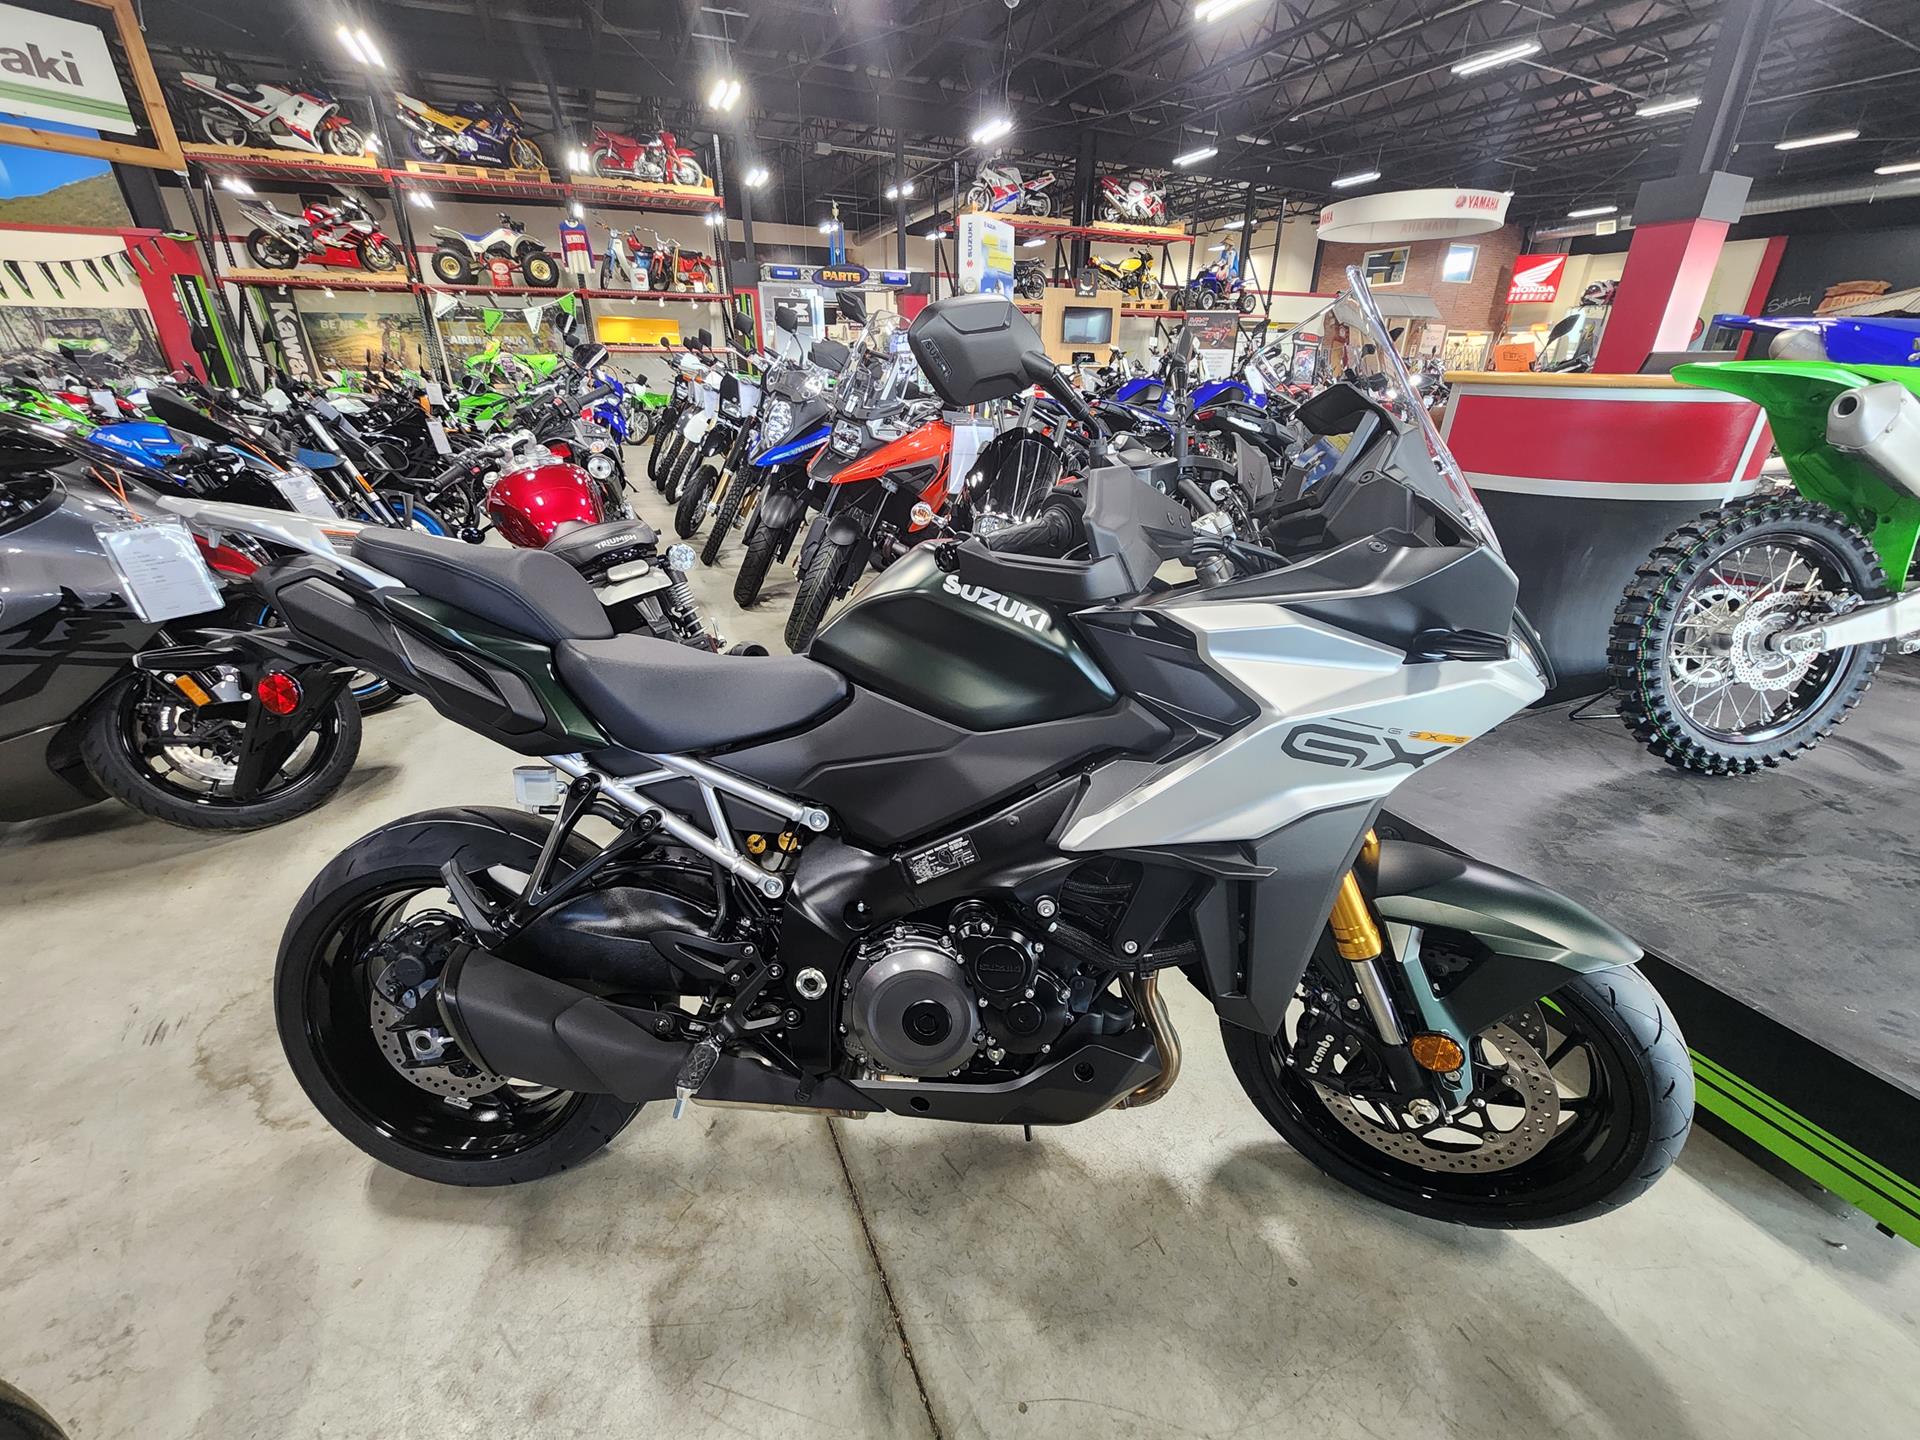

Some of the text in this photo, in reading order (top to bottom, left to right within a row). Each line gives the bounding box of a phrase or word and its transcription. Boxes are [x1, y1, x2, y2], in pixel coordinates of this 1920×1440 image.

[1468, 195, 1499, 209] YAMAHA
[822, 270, 861, 283] PARTS
[1507, 293, 1555, 301] SERVICE
[1511, 285, 1555, 293] HONDA
[1767, 293, 1812, 312] Saturday
[95, 432, 133, 448] SUZUKI
[594, 533, 637, 550] TRIUMPH
[942, 574, 1049, 632] SUZUKI
[1304, 1034, 1335, 1074] brembo
